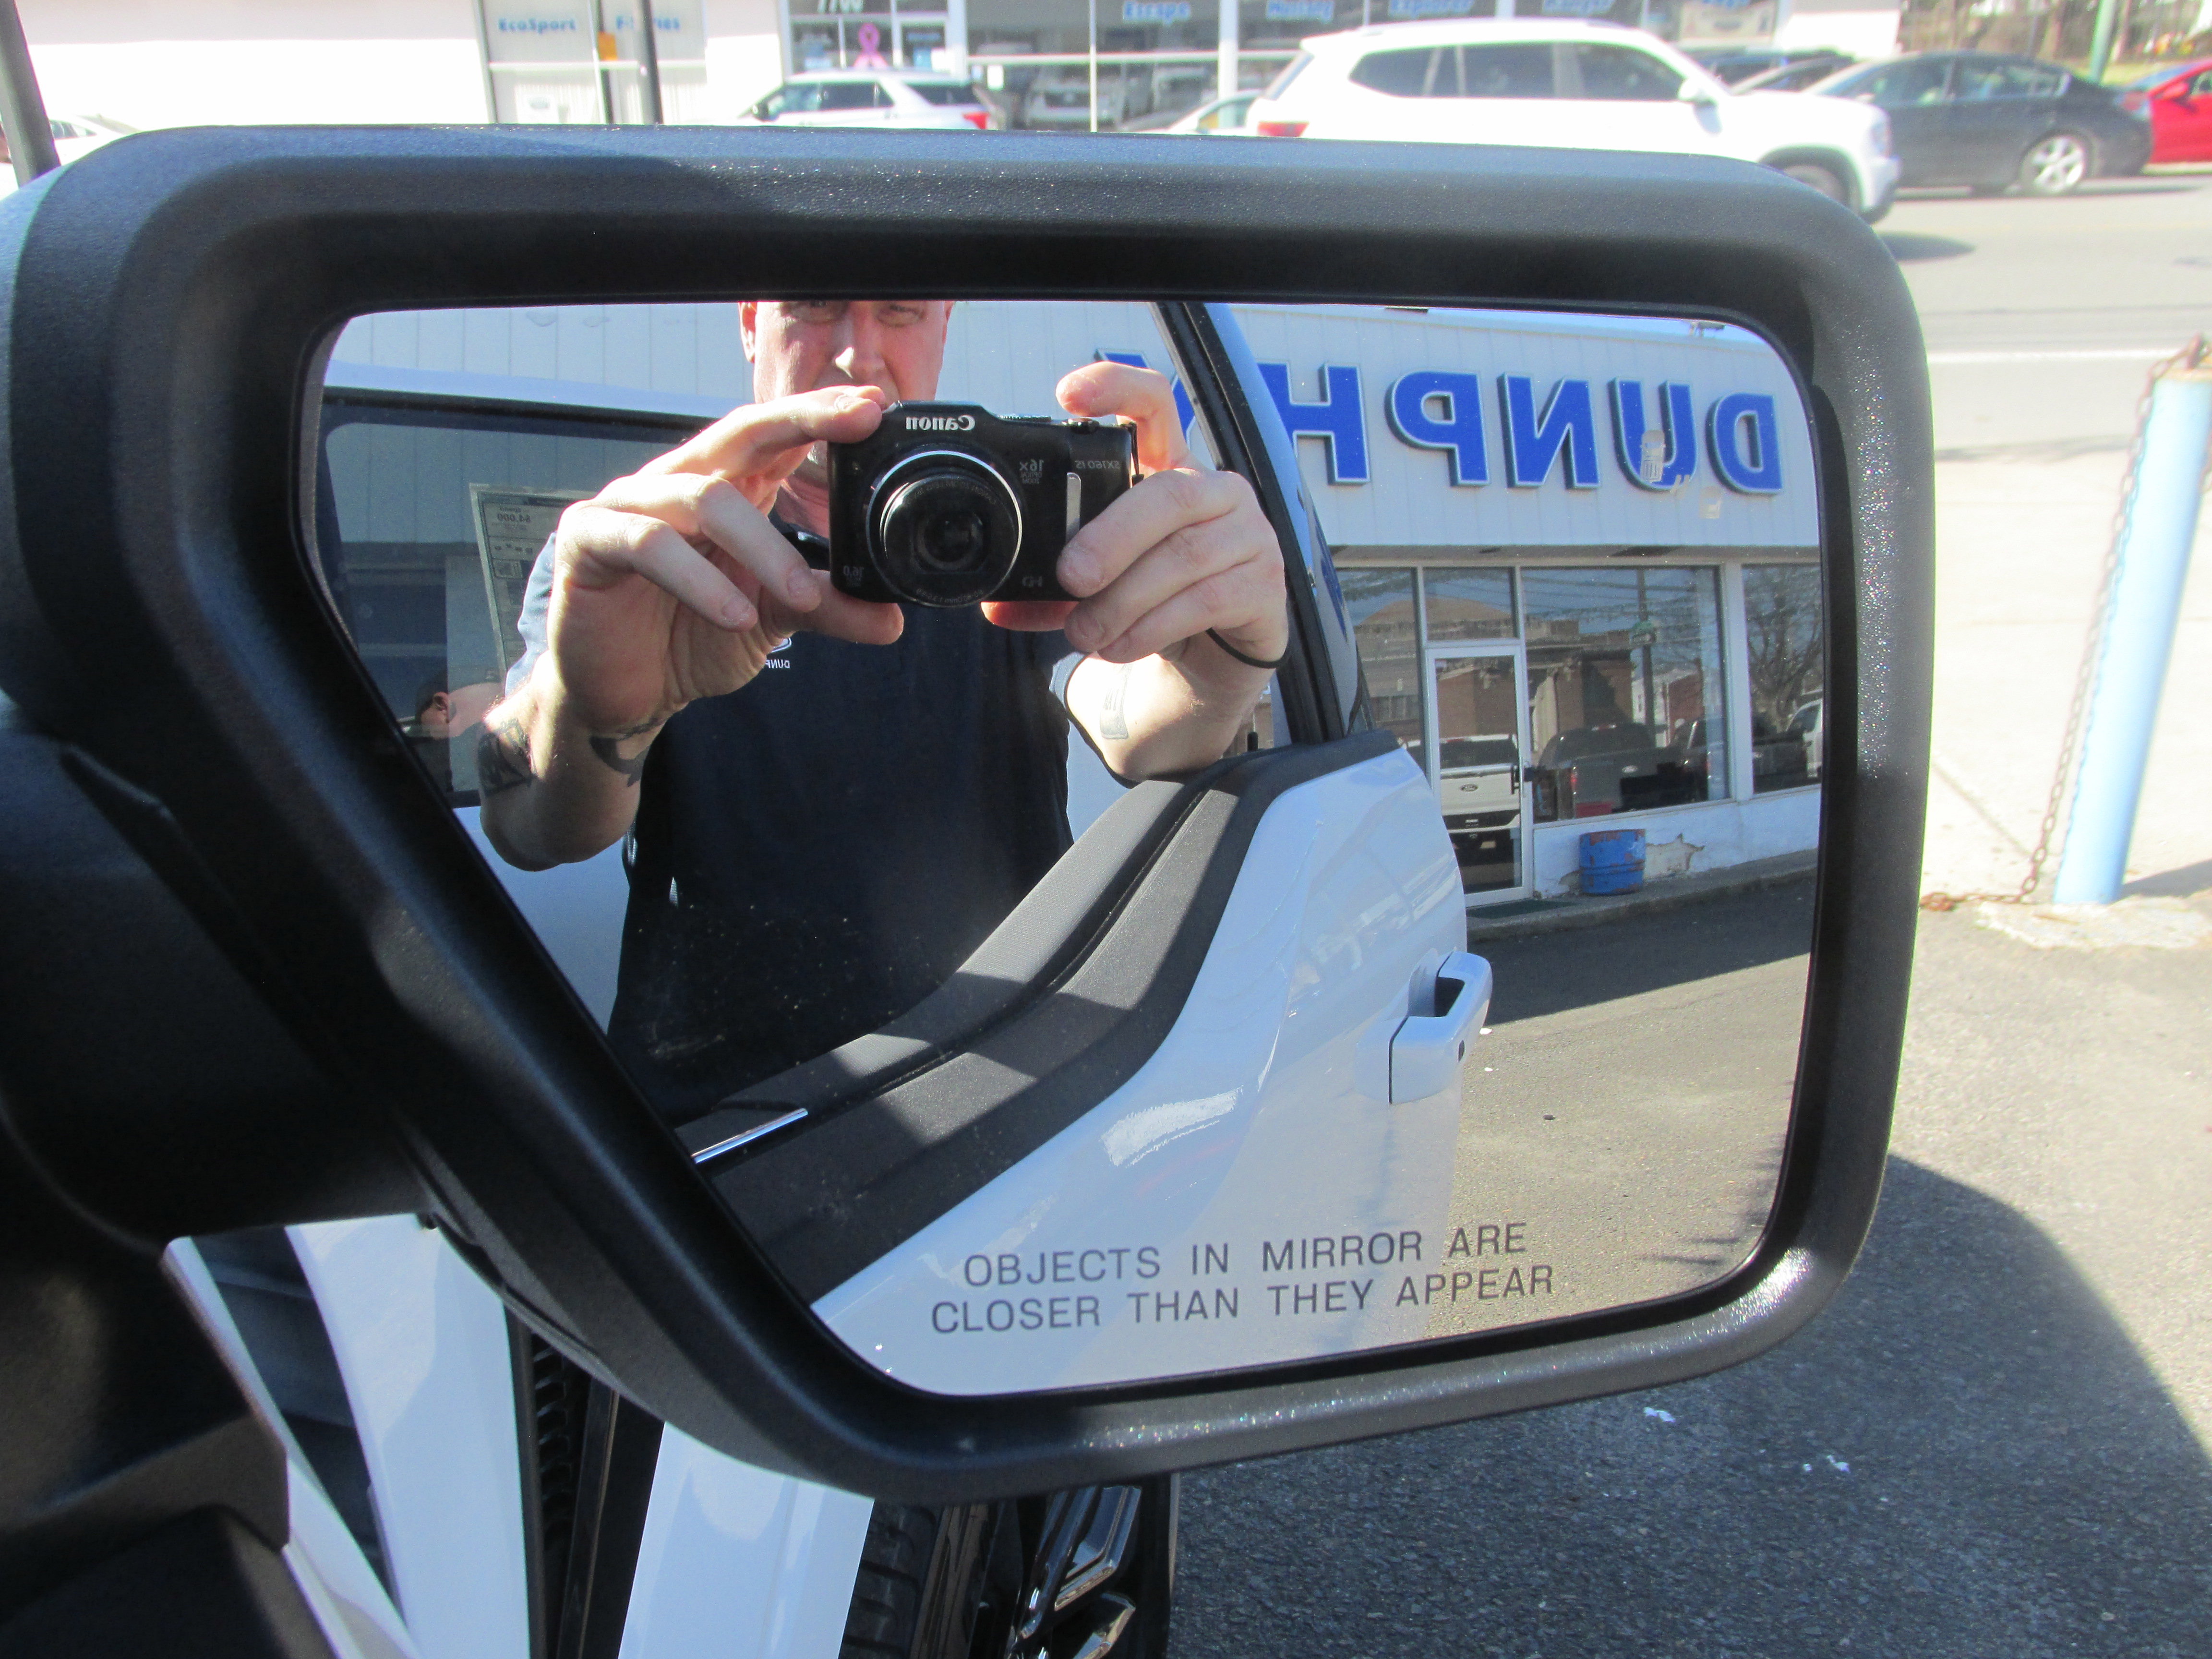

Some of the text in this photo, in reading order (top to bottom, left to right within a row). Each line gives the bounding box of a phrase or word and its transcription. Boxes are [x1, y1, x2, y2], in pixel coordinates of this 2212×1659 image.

[498, 17, 576, 33] EcoSport
[963, 1222, 1527, 1287] OBJECTS IN MIRROR ARE
[930, 1264, 1554, 1334] CLOSER THAN THEY APPEAR
